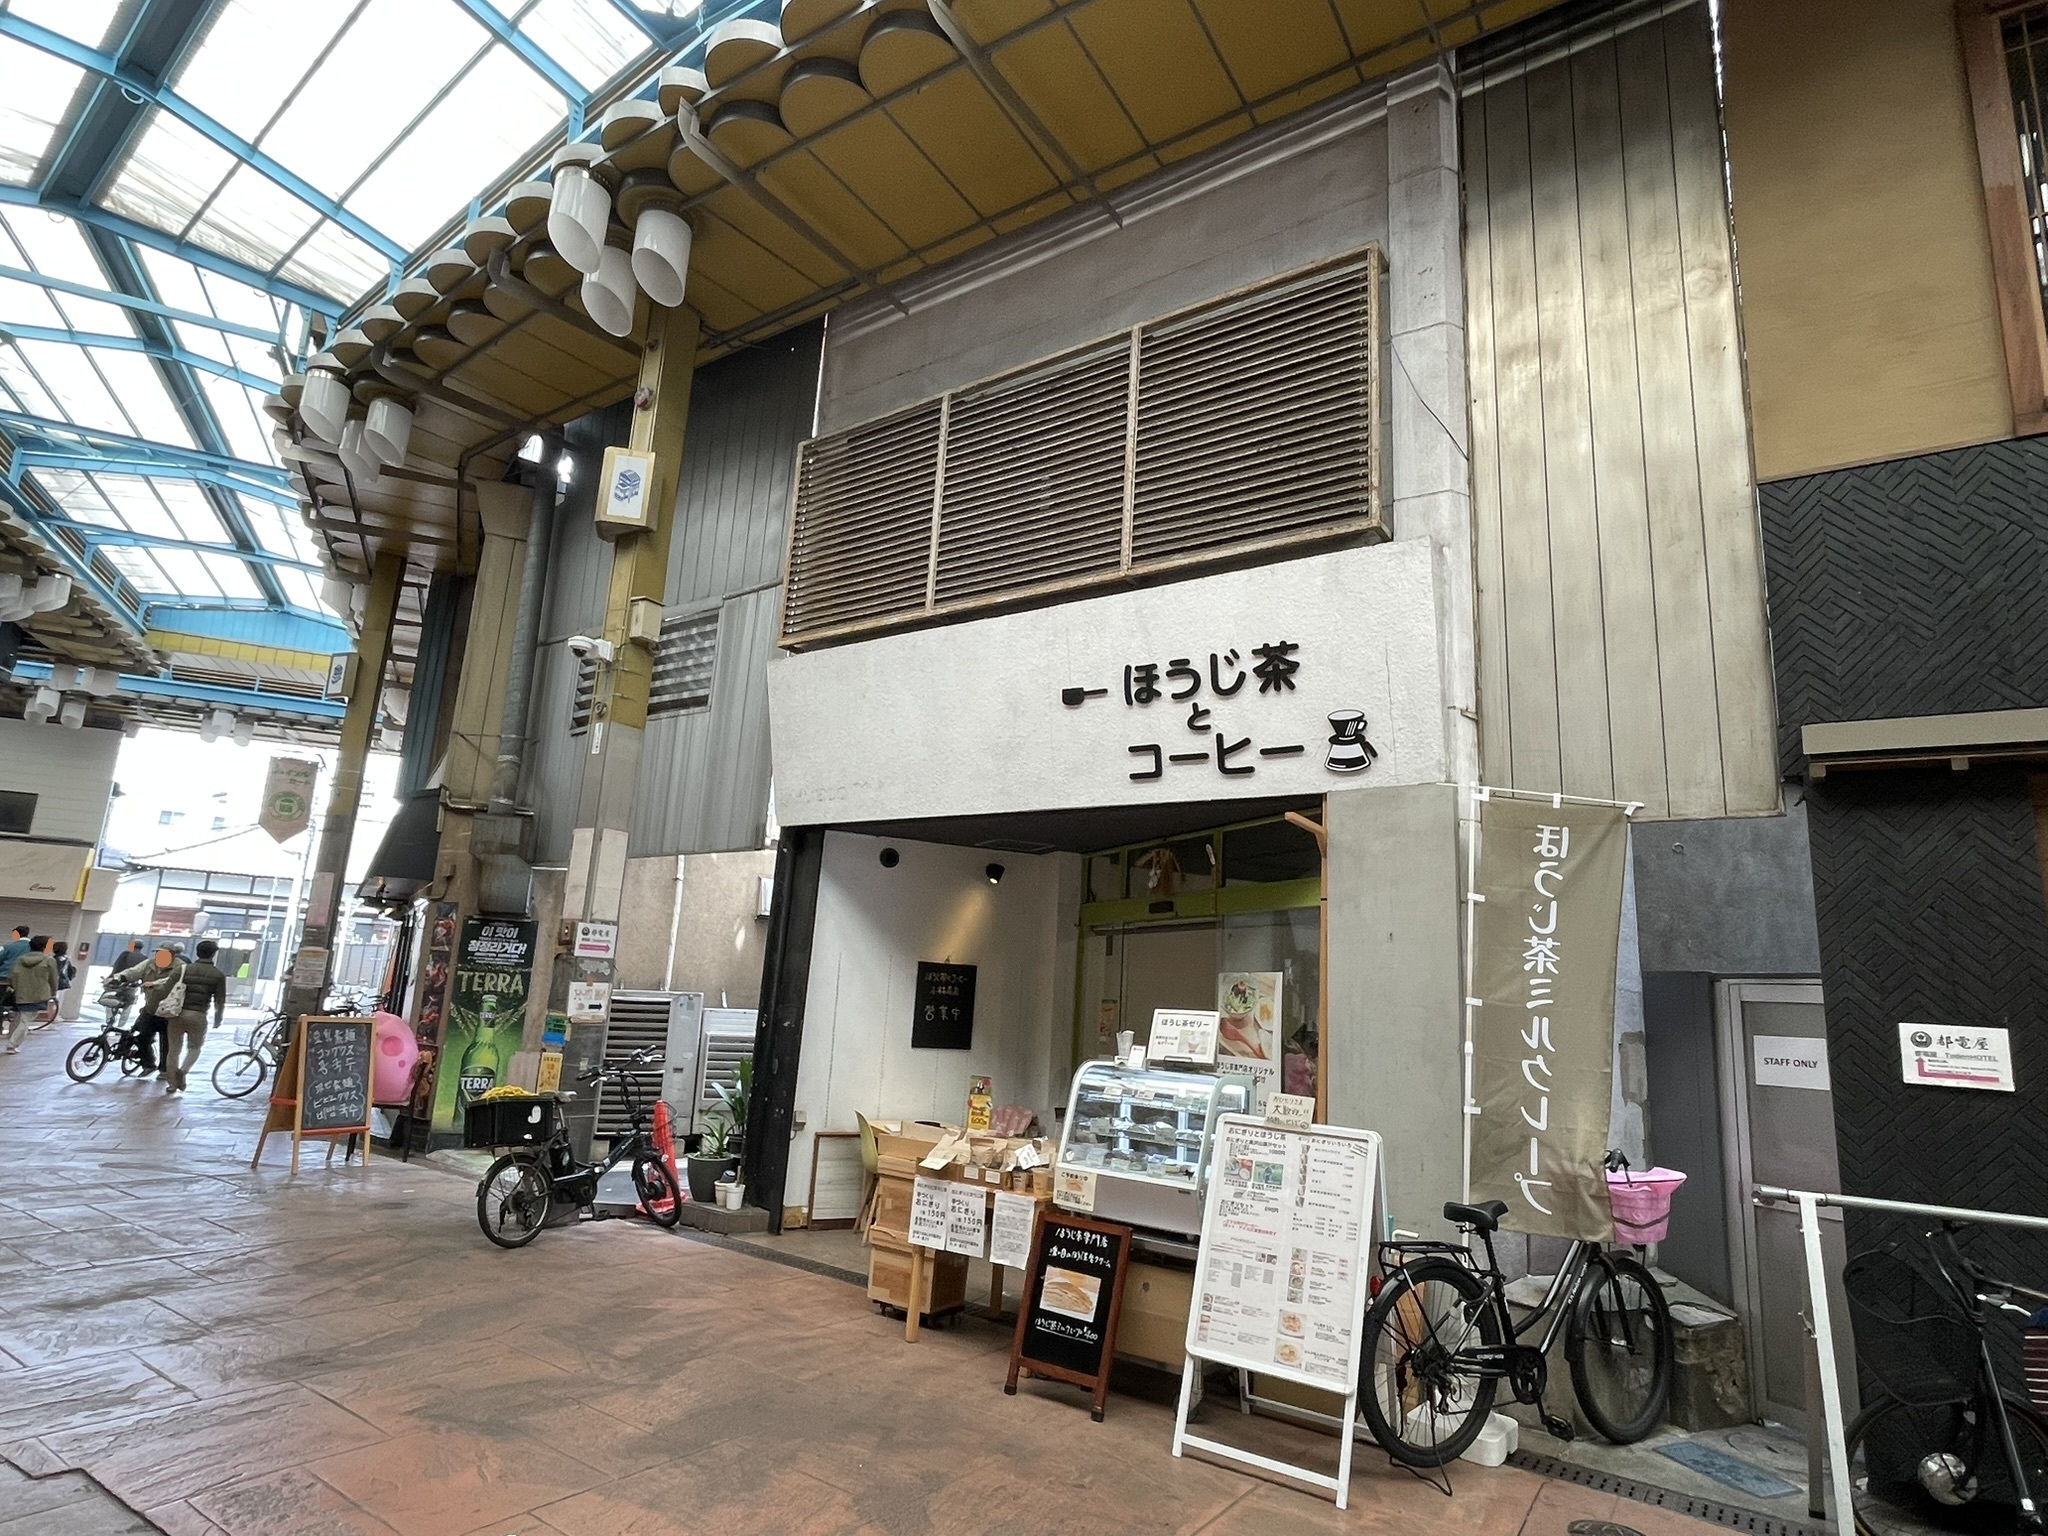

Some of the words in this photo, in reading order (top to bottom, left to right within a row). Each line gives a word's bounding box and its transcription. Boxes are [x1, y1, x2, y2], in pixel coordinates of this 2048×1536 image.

[1123, 640, 1300, 706] ほうじ茶
[1187, 702, 1211, 731] と
[1128, 733, 1305, 780] コーヒー
[457, 970, 524, 996] TERRA
[1161, 1018, 1210, 1028] ほうじ茶ゼリー
[1763, 1057, 1790, 1067] STAFF
[1792, 1059, 1818, 1069] ONLY
[460, 1077, 494, 1090] TERRA
[915, 1198, 940, 1210] おにぎり
[950, 1205, 976, 1217] おにぎり
